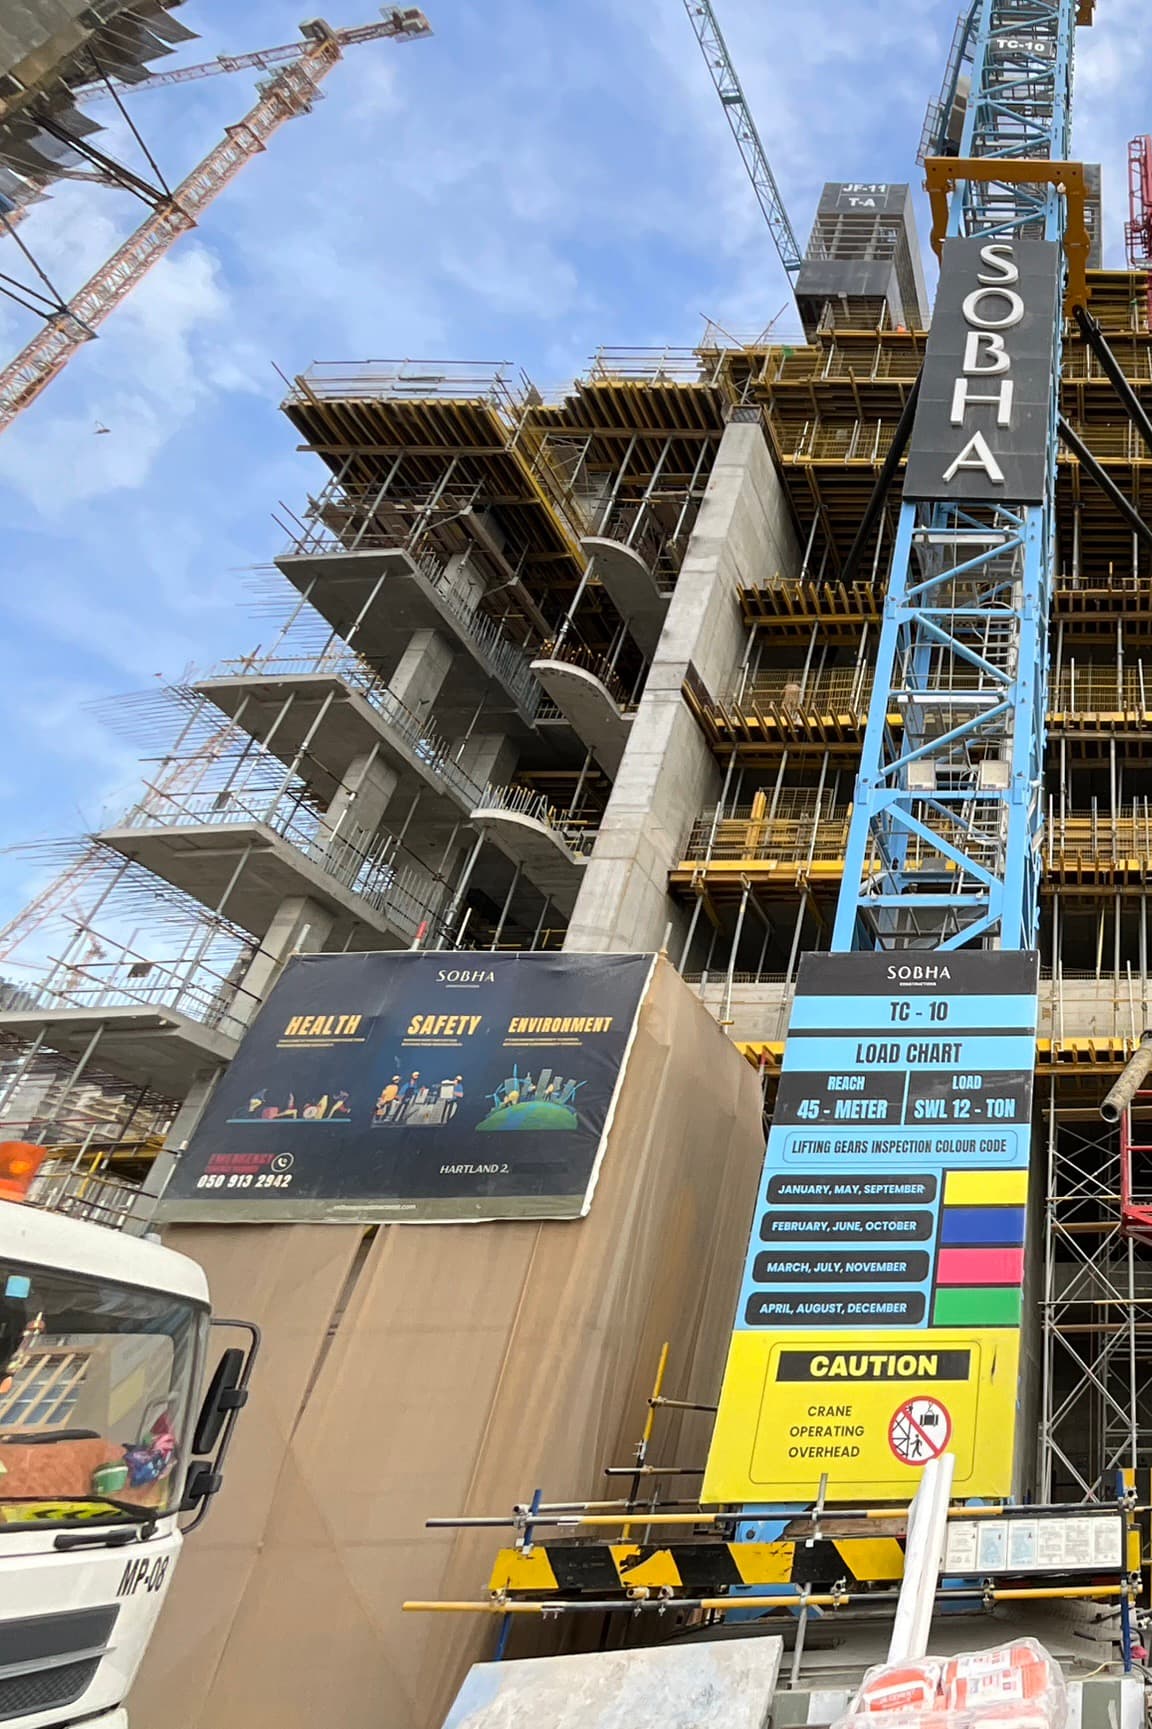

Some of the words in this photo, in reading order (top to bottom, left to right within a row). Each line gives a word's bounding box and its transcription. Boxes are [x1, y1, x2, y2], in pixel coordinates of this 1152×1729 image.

[997, 39, 1045, 52] TC-10
[849, 197, 876, 208] T-A
[942, 244, 1025, 484] SOBHA
[436, 970, 495, 982] SOBHA
[887, 965, 951, 979] SOBHA
[890, 1001, 910, 1021] TC
[929, 1001, 948, 1021] 10
[284, 1014, 363, 1035] HEALTH
[407, 1015, 482, 1035] SAFETY
[508, 1017, 613, 1033] ENVIRONMENT
[856, 1043, 899, 1063] LOAD
[906, 1043, 962, 1063] CHART
[827, 1076, 865, 1091] REACH
[952, 1075, 982, 1089] LOAD
[797, 1100, 819, 1118] 45
[835, 1100, 888, 1118] METER
[914, 1100, 948, 1118] SWL
[952, 1100, 969, 1118] 12
[986, 1099, 1015, 1118] TON
[792, 1140, 831, 1154] LIFTING
[834, 1140, 868, 1153] GEARS
[871, 1140, 932, 1153] INSPECTION
[935, 1139, 976, 1153] COLOUR
[979, 1139, 1006, 1152] CODE
[439, 1164, 499, 1174] HARTLAND
[197, 1174, 225, 1188] 050
[227, 1174, 253, 1188] 913
[254, 1174, 293, 1188] 2942
[778, 1185, 832, 1196] JANUARY,
[834, 1185, 862, 1196] MAY,
[864, 1184, 925, 1194] SEPTEMBER
[772, 1221, 830, 1232] FEBRUARY,
[832, 1221, 863, 1232] JUNE,
[865, 1221, 917, 1231] OCTOBER
[767, 1262, 811, 1273] MARCH,
[814, 1262, 843, 1273] JULY,
[846, 1262, 907, 1272] NOVEMBER
[760, 1303, 793, 1315] APRIL,
[796, 1303, 845, 1314] AUGUST,
[847, 1303, 907, 1313] DECEMBER
[809, 1355, 938, 1377] CAUTION
[807, 1405, 852, 1417] CRANE
[790, 1425, 865, 1438] OPERATING
[788, 1446, 860, 1458] OVERHEAD
[116, 1555, 169, 1597] MP-08
